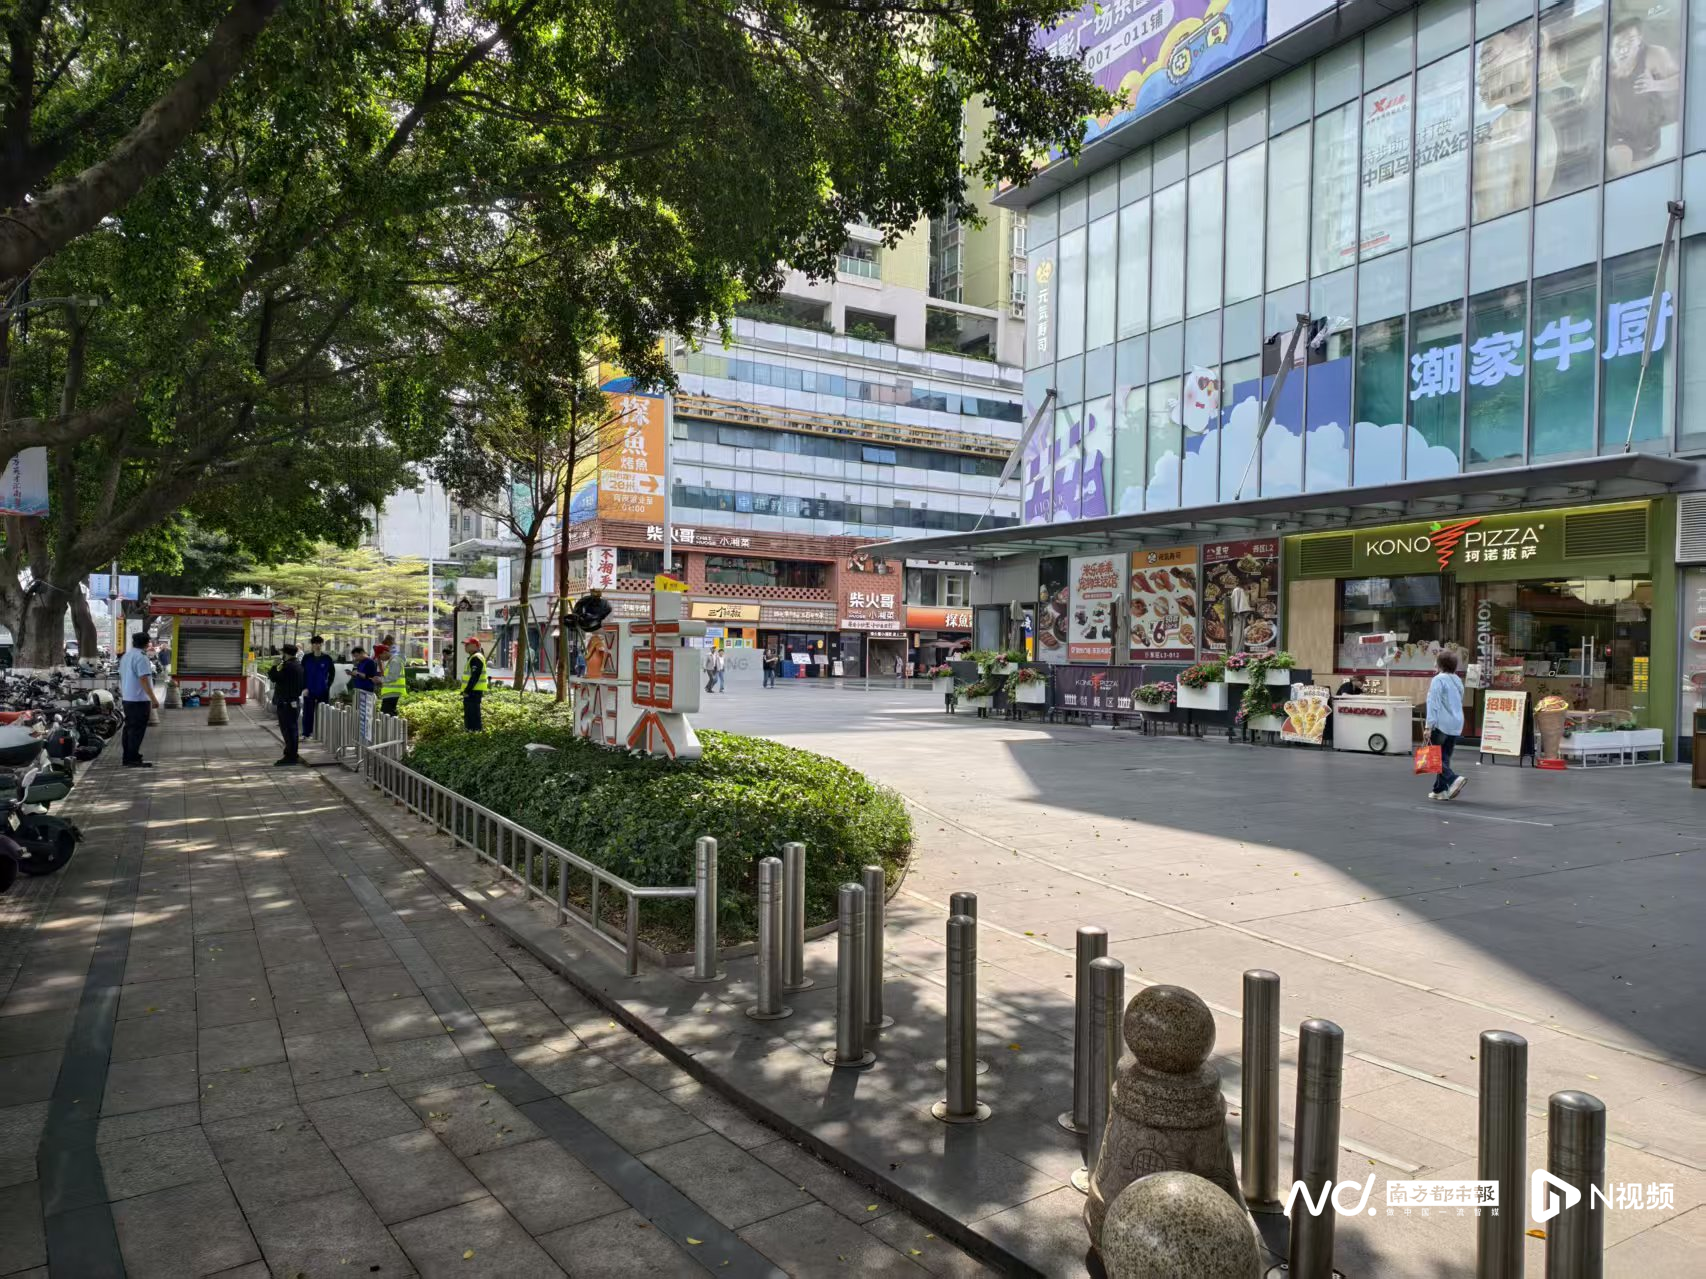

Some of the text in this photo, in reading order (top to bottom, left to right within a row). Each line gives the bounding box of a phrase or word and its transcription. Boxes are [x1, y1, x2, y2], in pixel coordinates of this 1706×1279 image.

[1410, 291, 1673, 400] 潮家牛厨
[1366, 527, 1540, 557] KONO PIZZA
[1464, 546, 1537, 563] 珂诺披萨
[849, 591, 895, 609] 柴火哥
[1486, 697, 1517, 712] 招聘!
